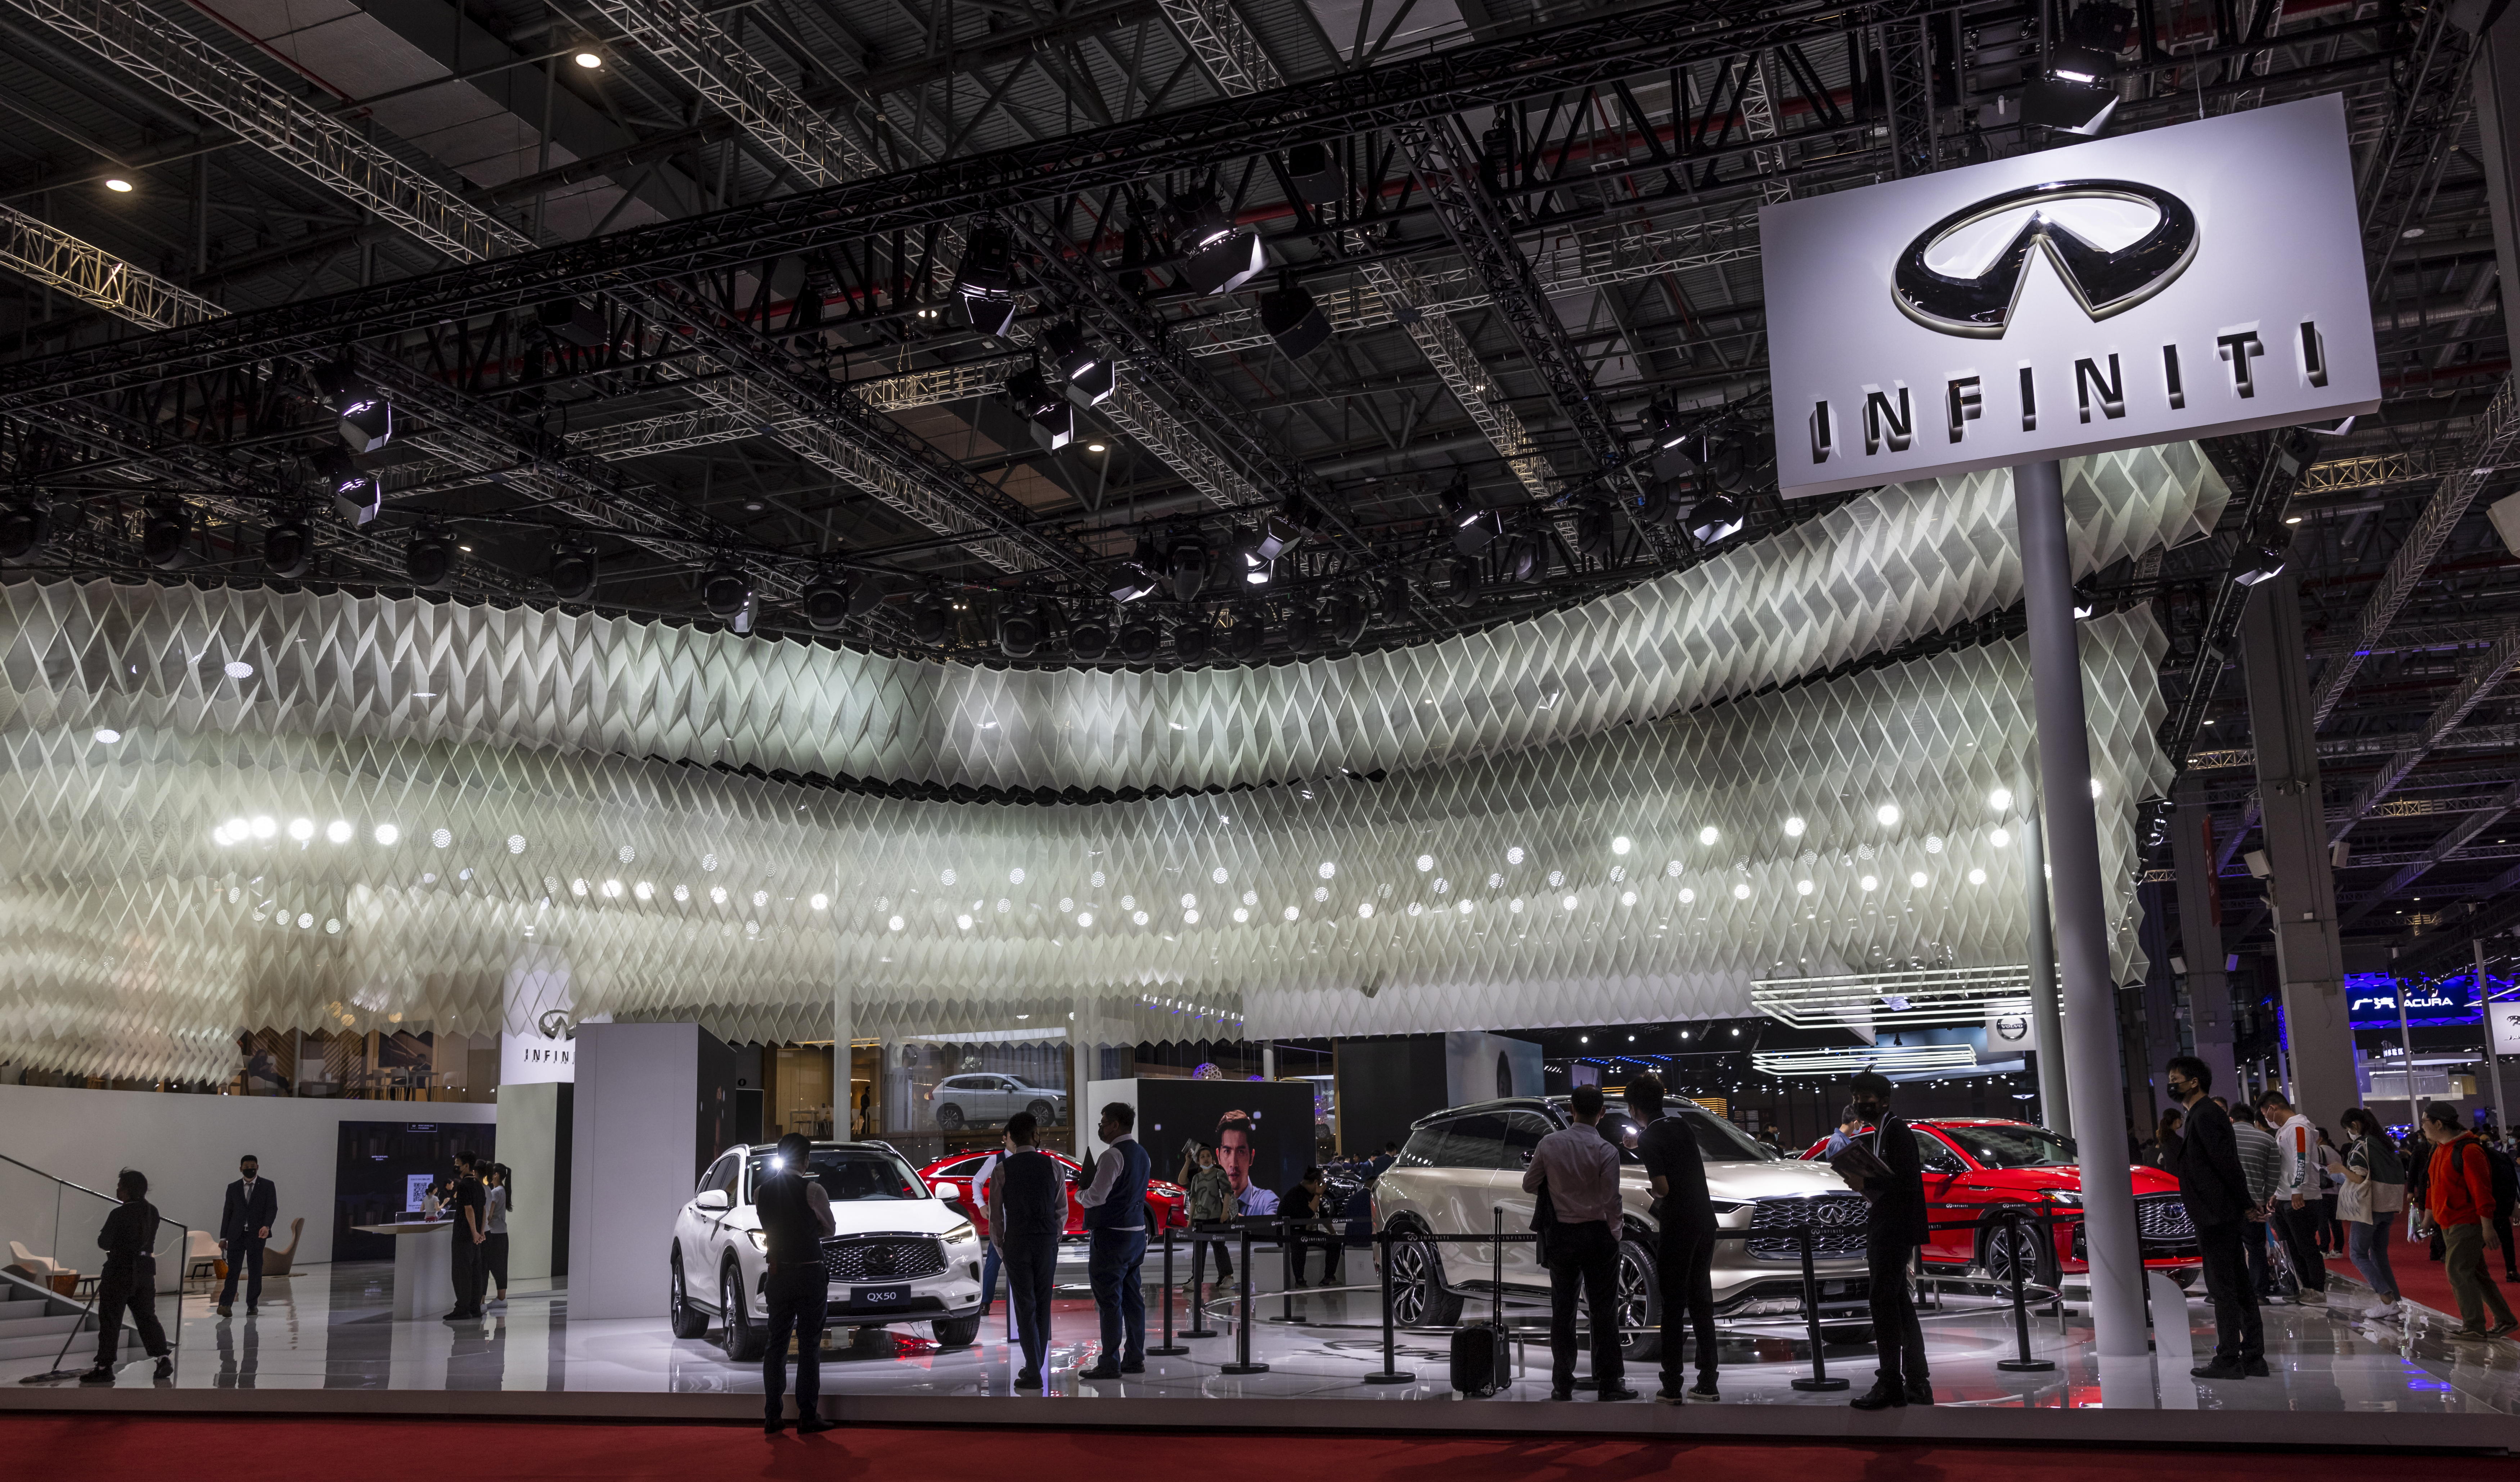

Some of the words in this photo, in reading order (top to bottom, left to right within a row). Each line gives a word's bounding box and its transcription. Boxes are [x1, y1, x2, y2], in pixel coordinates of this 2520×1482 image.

[1812, 321, 2327, 460] INFINITI
[2352, 995, 2396, 1010] 广汽
[2404, 997, 2453, 1007] ACURA
[2296, 1159, 2305, 1183] FOREST
[867, 1292, 896, 1302] QX50
